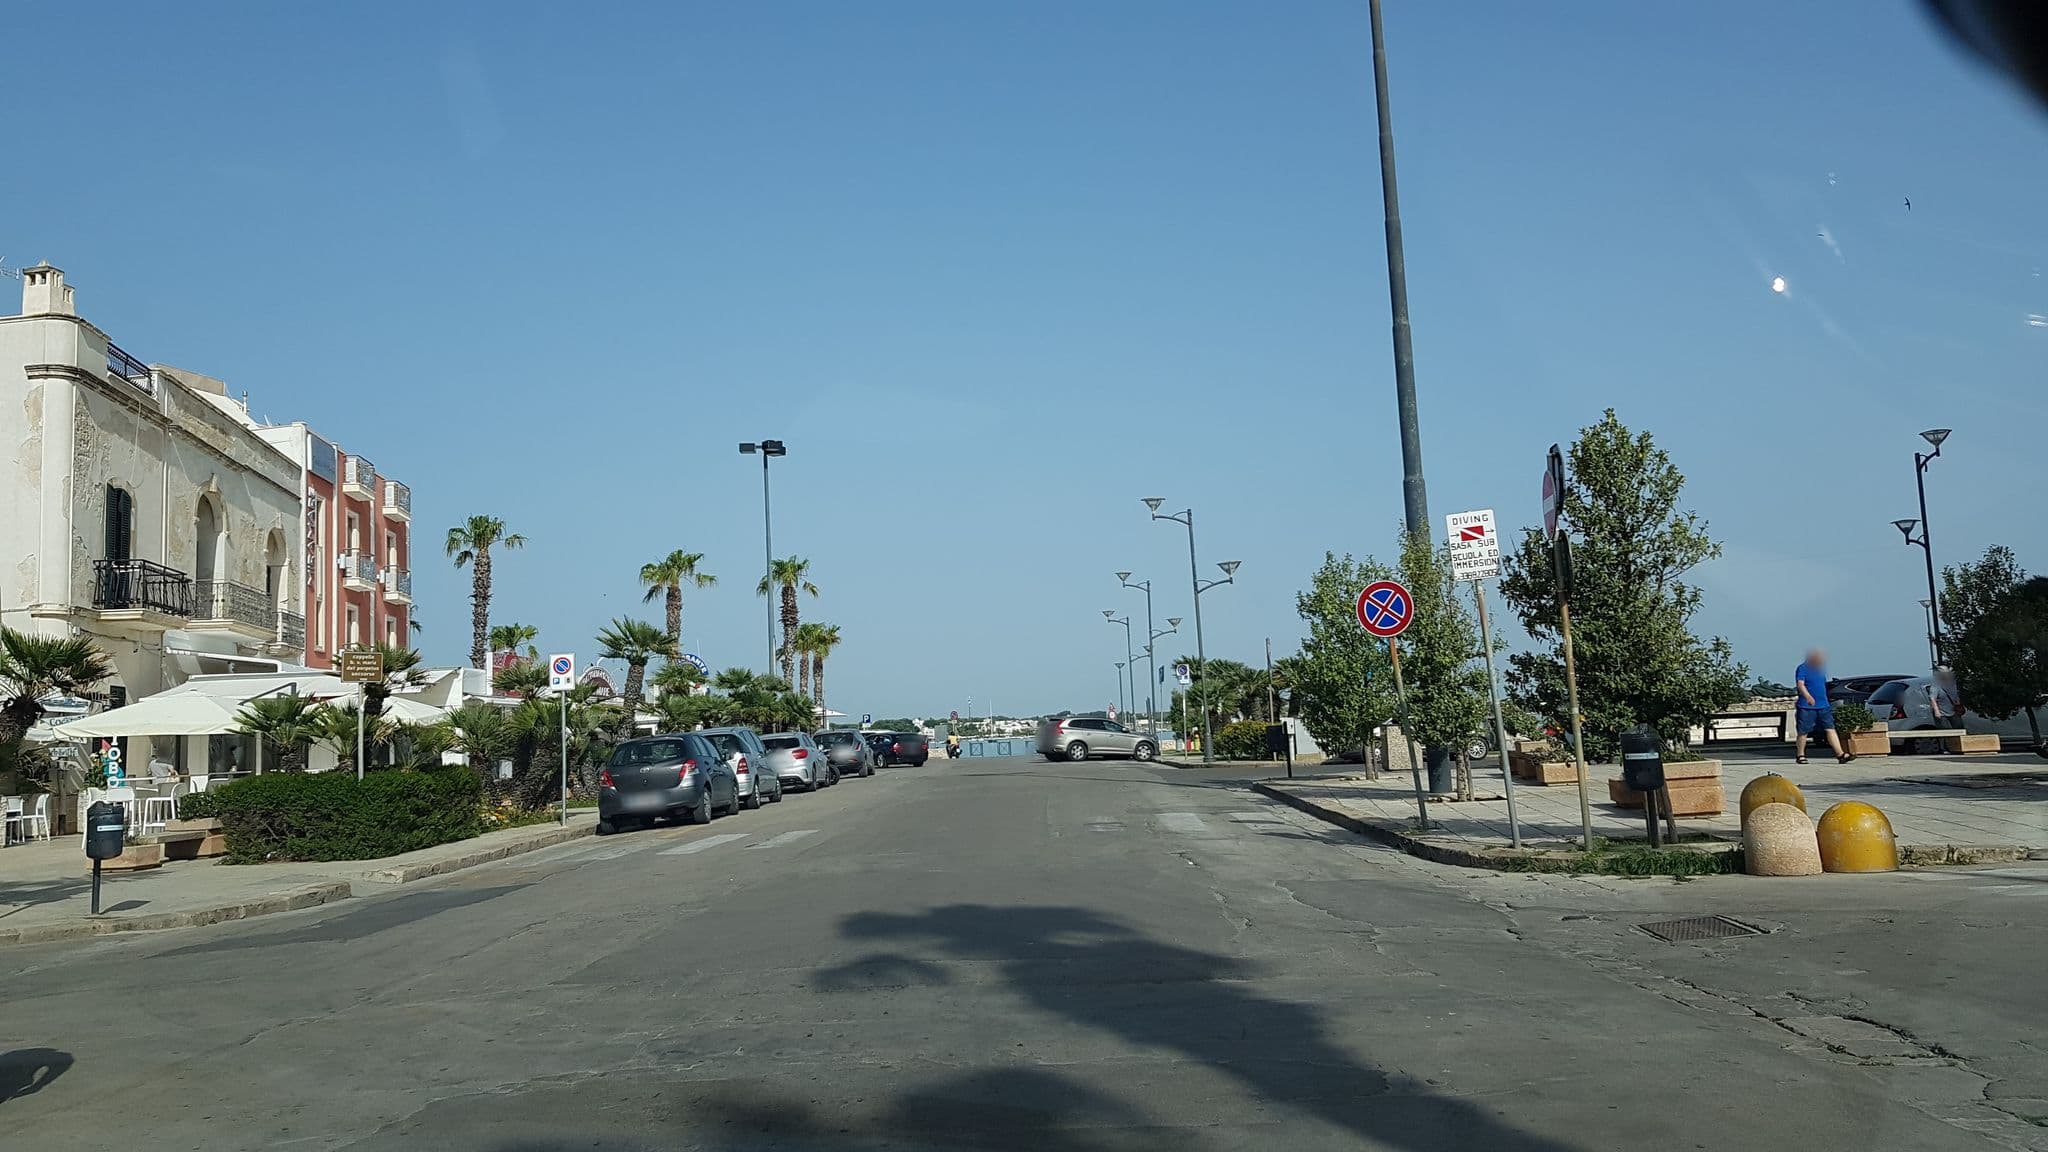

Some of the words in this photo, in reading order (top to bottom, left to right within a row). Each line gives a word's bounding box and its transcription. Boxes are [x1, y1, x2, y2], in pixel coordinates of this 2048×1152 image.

[1452, 514, 1488, 525] DIVING
[1451, 542, 1472, 550] SASA
[1477, 538, 1495, 548] SUB
[1452, 551, 1483, 562] SCUOLA
[1487, 548, 1498, 558] ED
